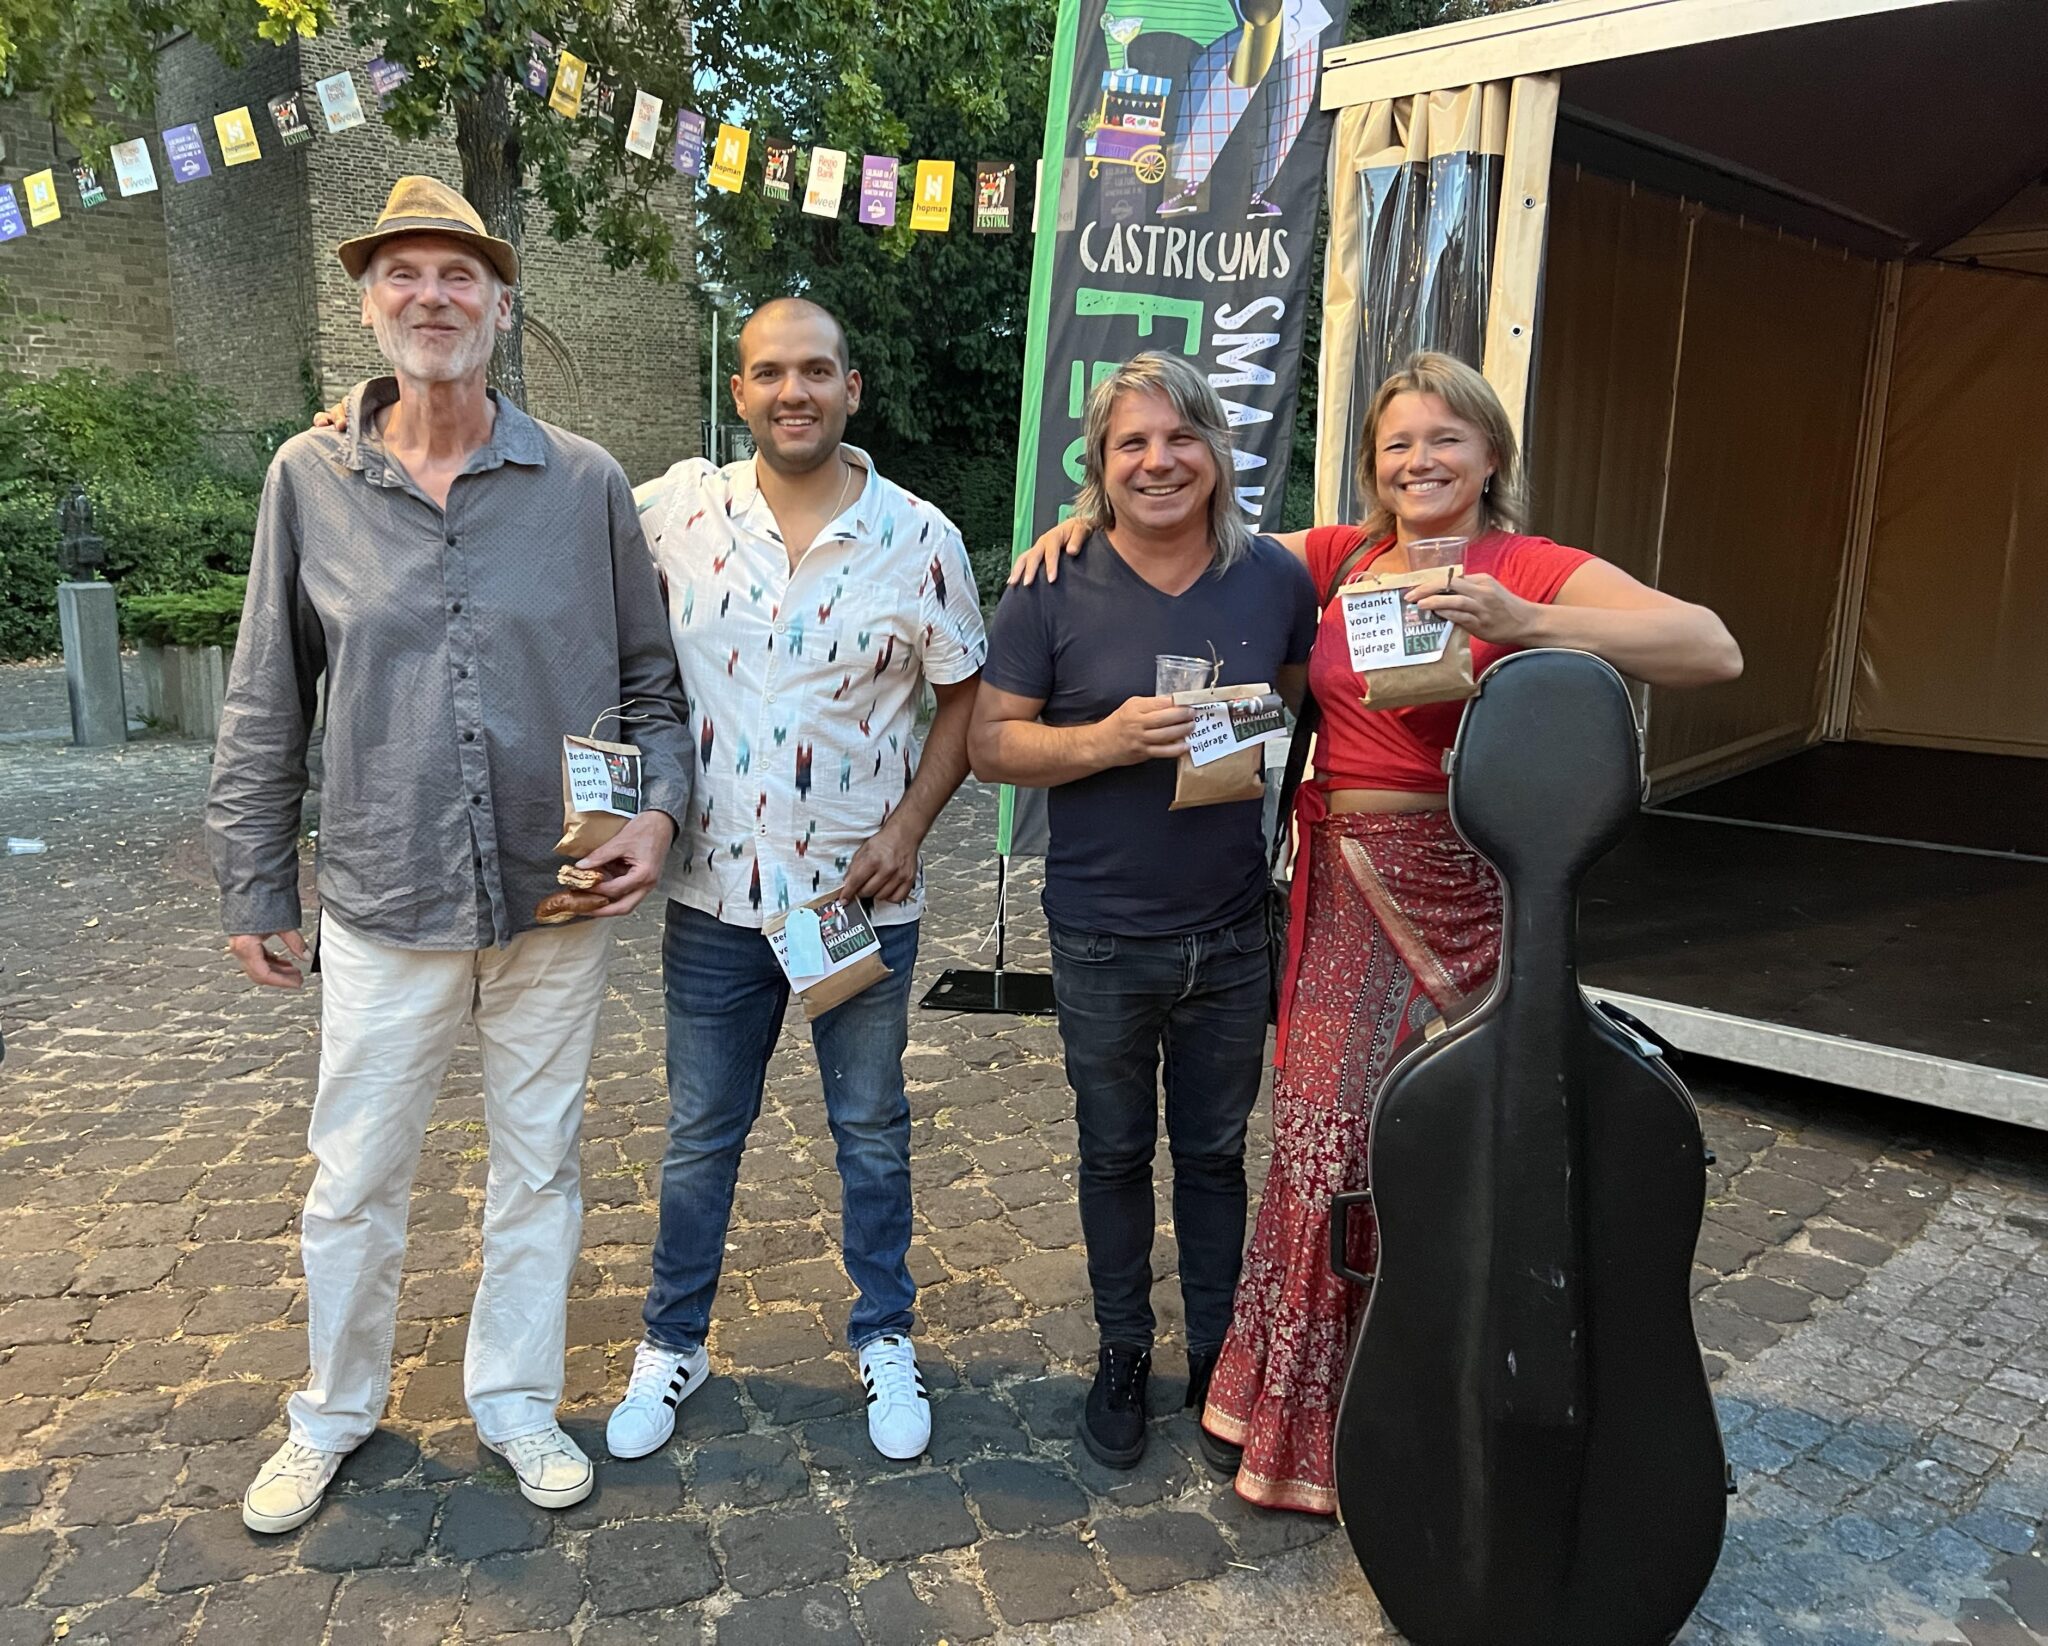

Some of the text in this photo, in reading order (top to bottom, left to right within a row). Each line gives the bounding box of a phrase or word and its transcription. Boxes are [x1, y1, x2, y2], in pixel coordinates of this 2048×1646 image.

[714, 162, 741, 176] hopman
[916, 203, 948, 215] hopman
[976, 215, 1010, 228] FESTIVAL
[1079, 221, 1291, 283] CASTRICUMS
[1347, 596, 1393, 612] Bedankt
[1350, 613, 1386, 627] voor je
[1351, 628, 1393, 641] inzet en
[1353, 642, 1396, 657] bijdrage
[1212, 721, 1223, 731] en
[1192, 733, 1228, 753] bijdrage
[568, 752, 601, 761] Bedankt
[571, 766, 591, 774] voor
[574, 778, 597, 787] inzet
[825, 923, 865, 949] SMAAKMAKERS
[829, 931, 872, 961] FESTIVAL
